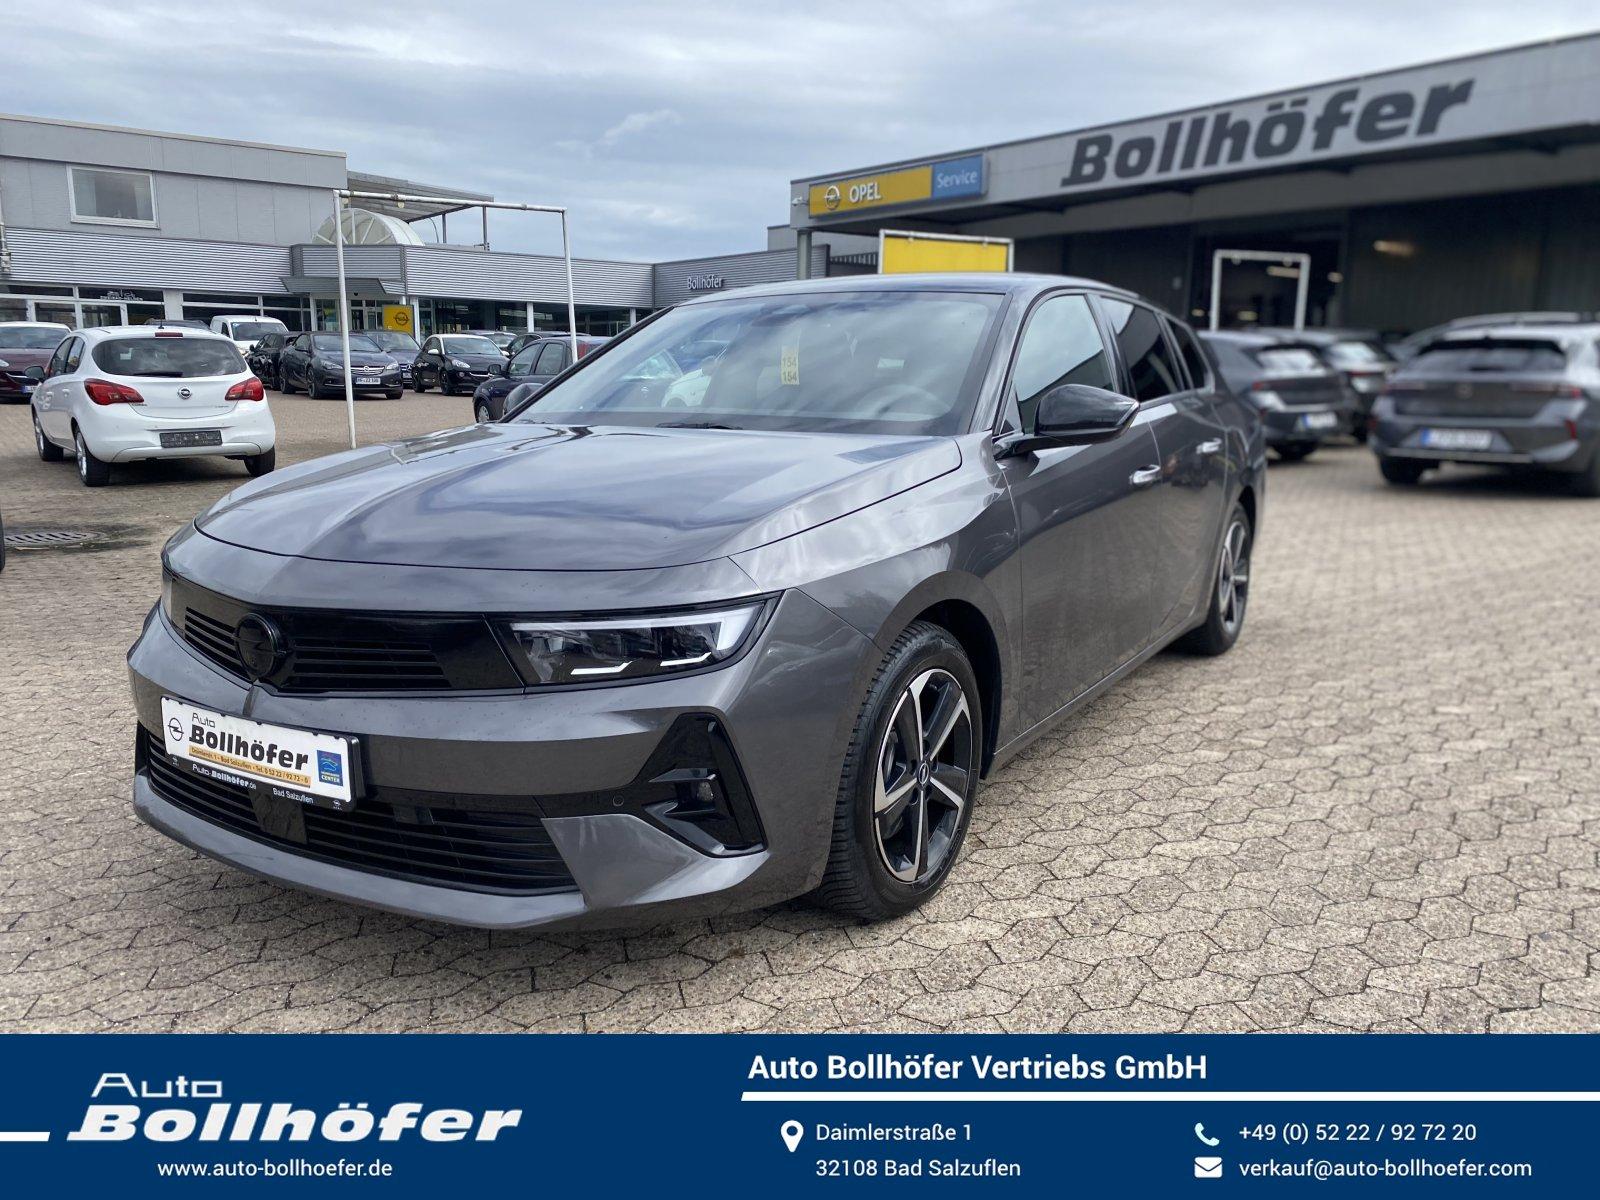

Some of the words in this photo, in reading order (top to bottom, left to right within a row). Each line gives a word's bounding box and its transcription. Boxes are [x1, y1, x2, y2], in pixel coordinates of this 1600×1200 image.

[1060, 78, 1475, 187] Bollhöfer
[936, 170, 978, 188] Service
[849, 182, 882, 203] OPEL
[783, 371, 798, 382] 154
[192, 712, 216, 728] Auto
[189, 724, 309, 770] Bollhöfer
[220, 756, 230, 764] Bad
[272, 787, 285, 798] Bad
[285, 790, 314, 804] Salzuflen
